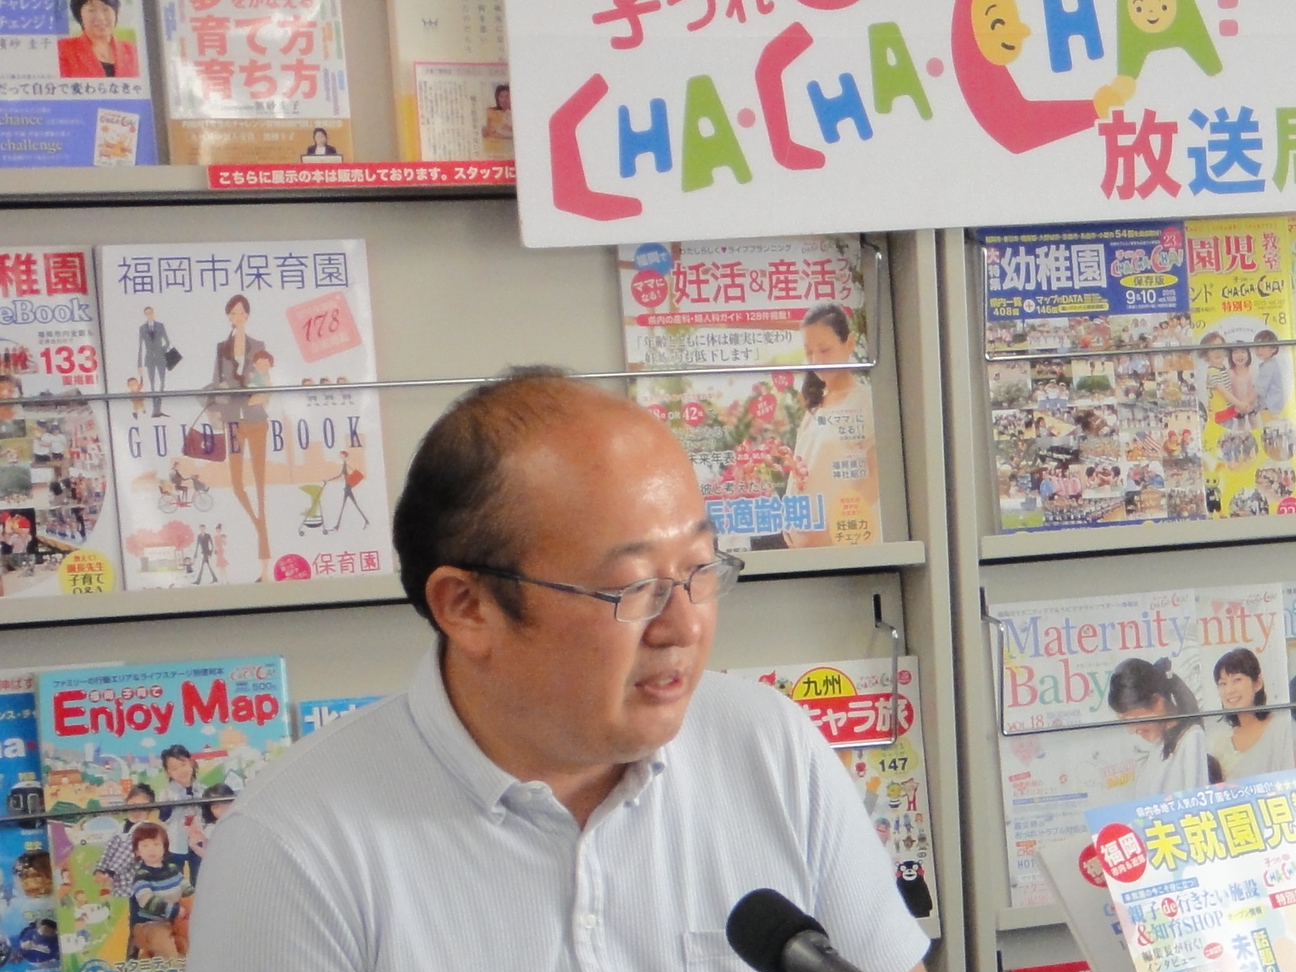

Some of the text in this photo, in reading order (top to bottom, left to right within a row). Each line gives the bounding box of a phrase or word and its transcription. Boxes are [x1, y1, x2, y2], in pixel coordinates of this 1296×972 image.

[189, 15, 317, 56] 育て方
[196, 59, 321, 100] 育ち方
[118, 252, 349, 294] 福岡市保育園
[1001, 243, 1108, 291] 幼稚園
[1187, 234, 1257, 273] 園児
[1133, 276, 1165, 286] 保存版
[40, 345, 98, 374] 133
[128, 416, 363, 459] GUIDE BOOK
[313, 551, 381, 575] 保育園
[1004, 609, 1191, 659] Maternity
[803, 674, 842, 697] 九州
[1007, 658, 1113, 713] Baby
[52, 679, 279, 738] Enjoy Map
[879, 757, 909, 773] 147
[1100, 832, 1145, 867] 福岡
